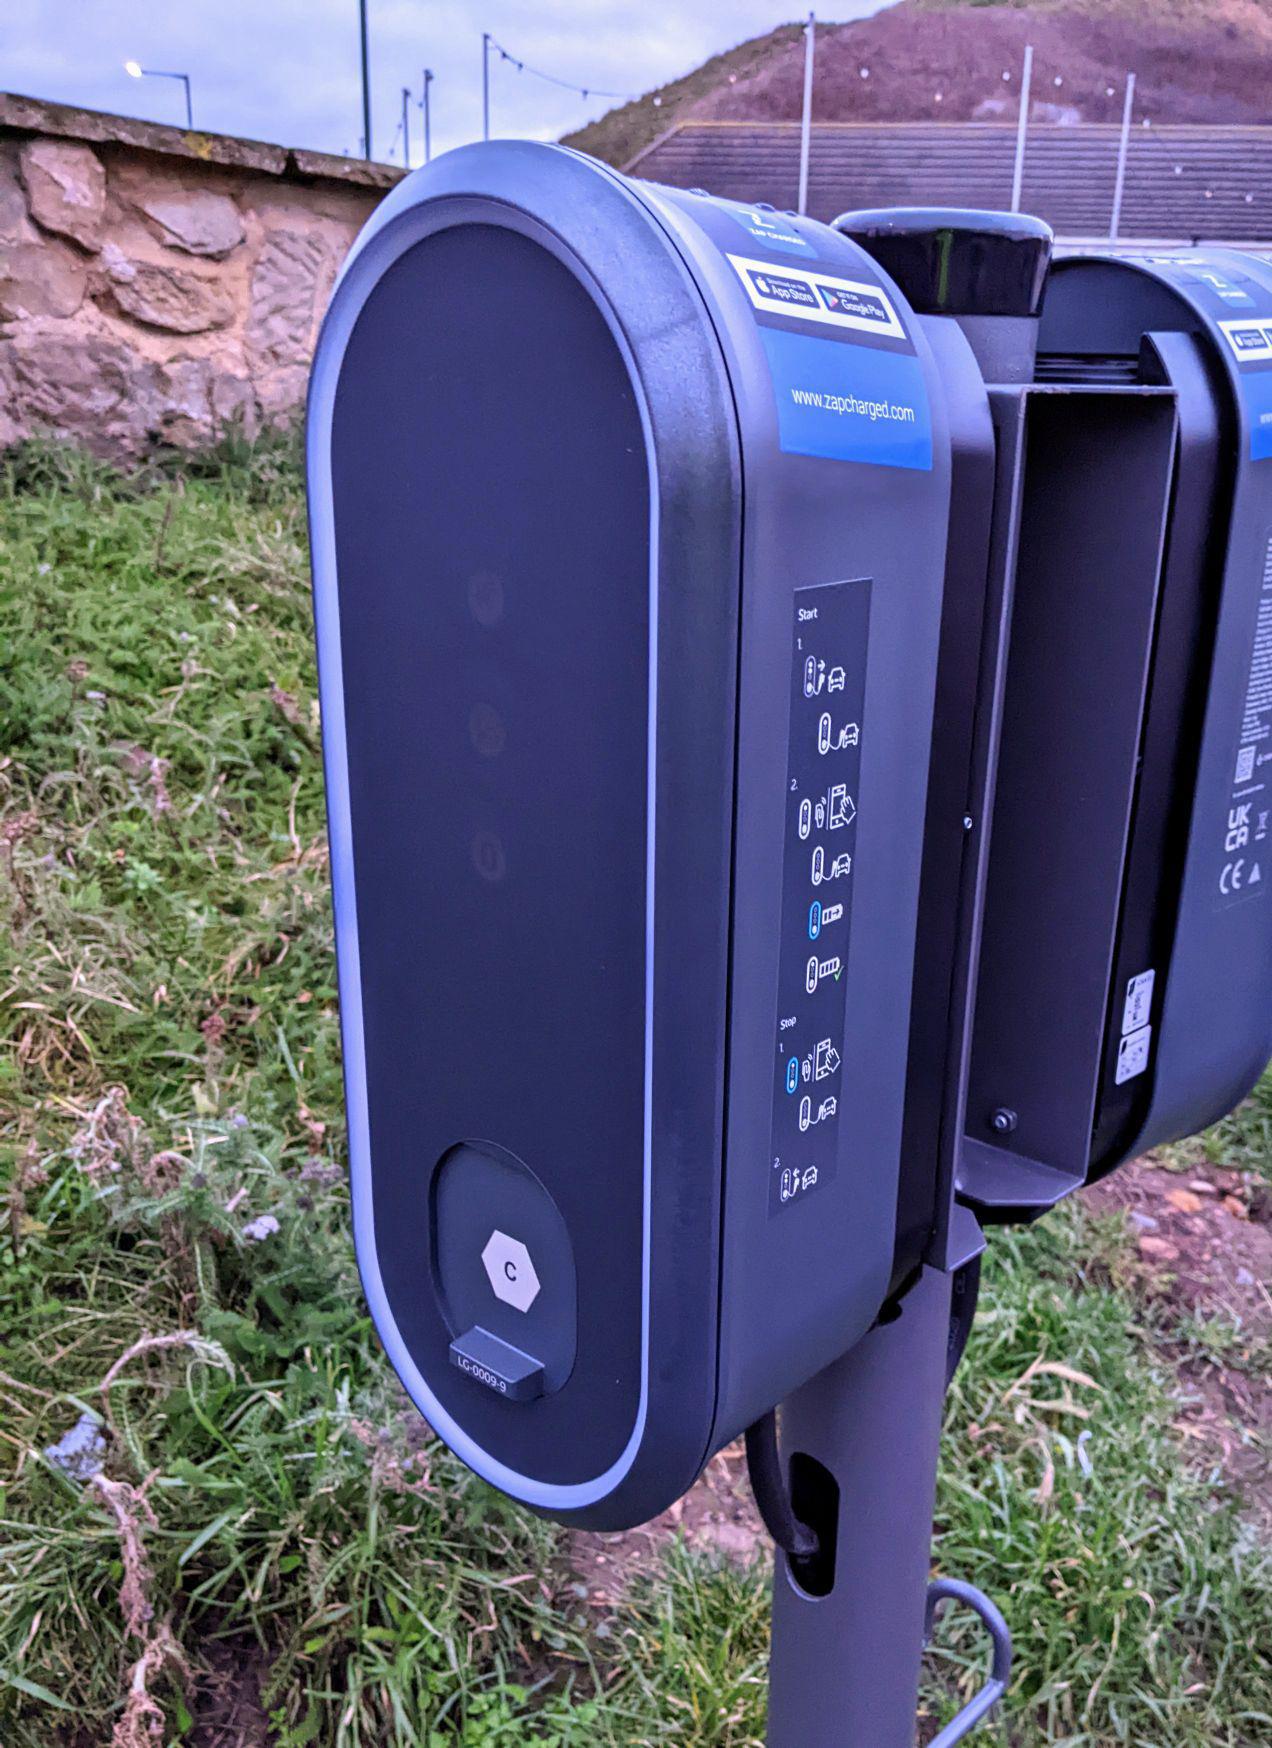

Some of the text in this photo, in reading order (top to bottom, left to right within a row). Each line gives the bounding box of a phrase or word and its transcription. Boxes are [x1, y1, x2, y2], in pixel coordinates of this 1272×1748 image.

[771, 284, 815, 304] App Store
[841, 299, 886, 320] Google Play
[791, 388, 915, 422] www.zapcharged.com
[798, 607, 818, 621] Start
[1228, 802, 1252, 829] UK
[1224, 825, 1249, 852] CA
[1219, 858, 1245, 895] CE
[780, 1016, 797, 1030] Stop
[504, 1261, 517, 1282] C
[457, 1355, 507, 1393] LG-0009-9
